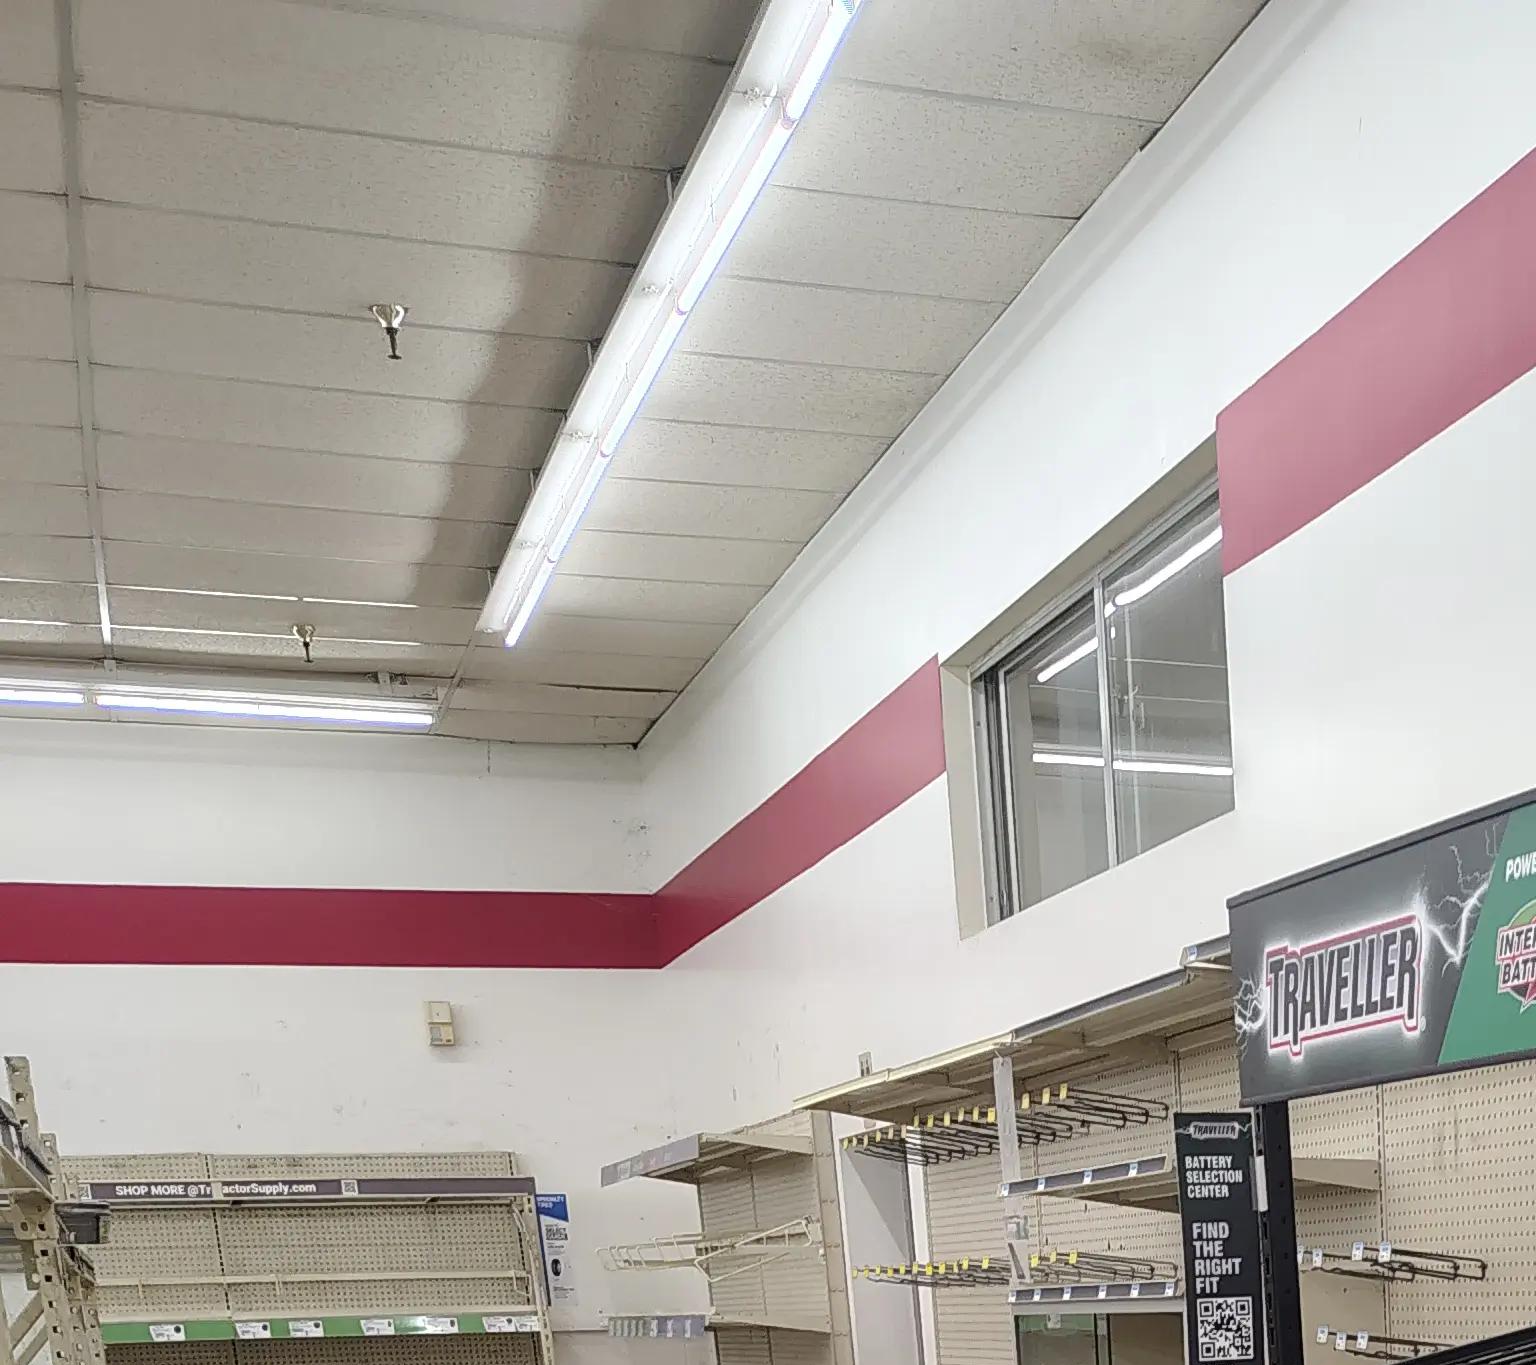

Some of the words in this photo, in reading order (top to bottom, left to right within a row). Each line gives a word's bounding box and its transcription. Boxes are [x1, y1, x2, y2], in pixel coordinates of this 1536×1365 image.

[1268, 925, 1418, 1046] TRAVELLER
[1184, 1155, 1233, 1169] BATTERY
[1185, 1169, 1243, 1184] SELECTION
[115, 1185, 149, 1196] SHOP
[150, 1184, 187, 1195] MORE
[1187, 1184, 1230, 1199] CENTER
[1192, 1221, 1230, 1240] FIND
[1192, 1240, 1224, 1258] THE
[1194, 1258, 1242, 1276] RIGHT
[1195, 1276, 1220, 1295] FIT
